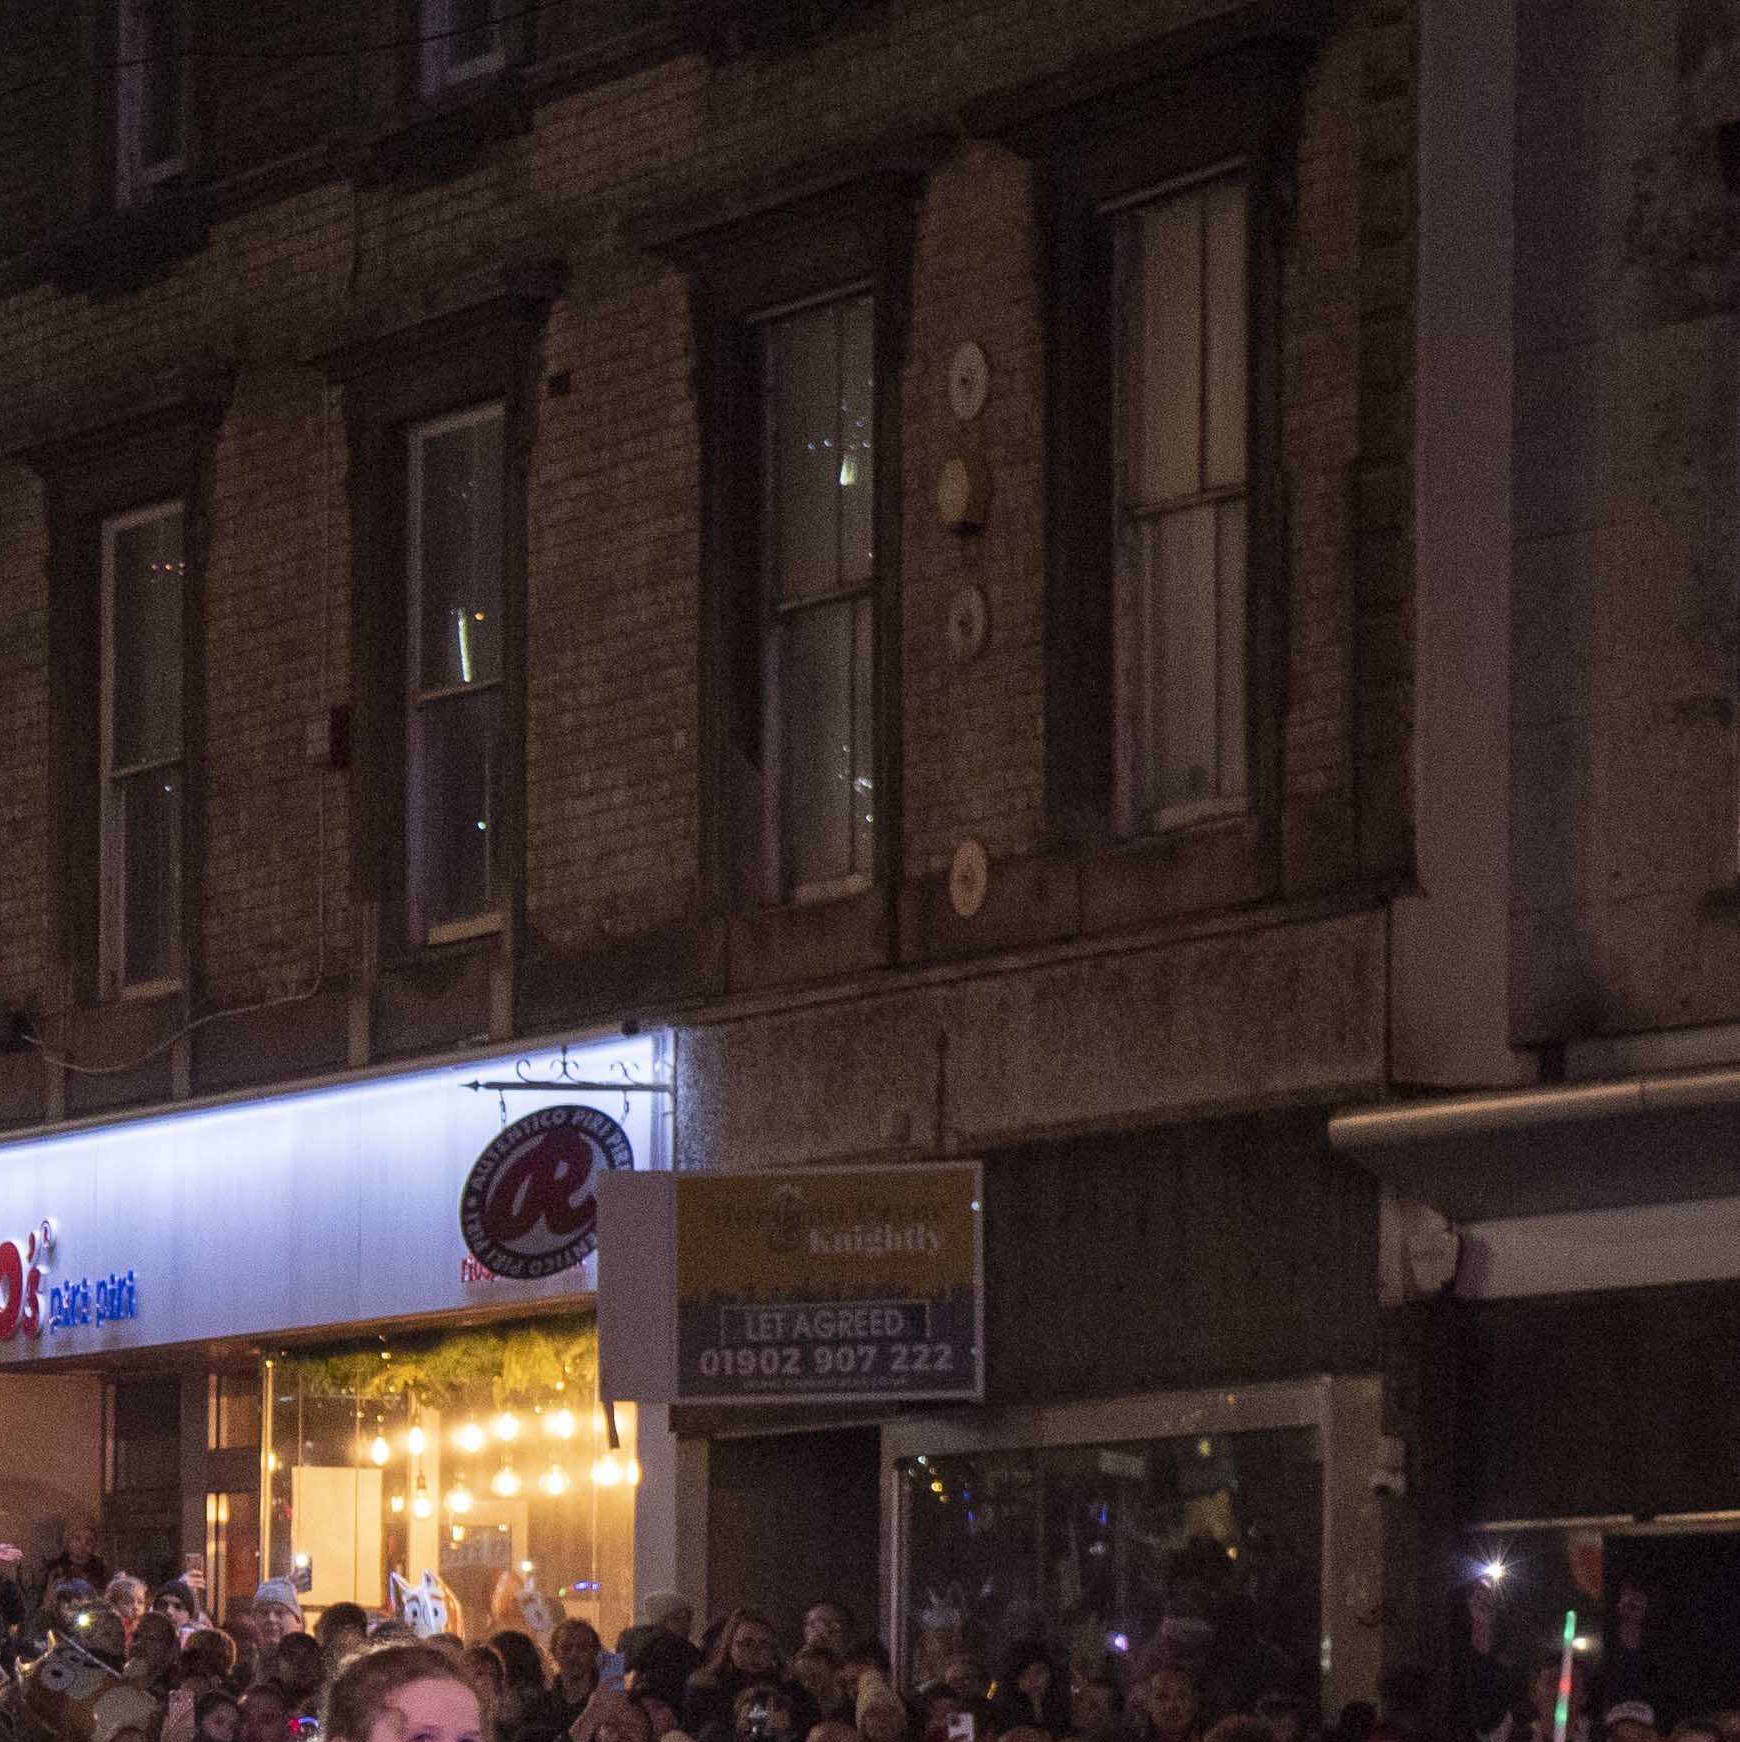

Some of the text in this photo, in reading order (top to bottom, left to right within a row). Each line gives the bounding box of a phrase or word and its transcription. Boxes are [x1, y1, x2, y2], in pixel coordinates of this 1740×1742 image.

[745, 1309, 905, 1341] LET AGREED
[699, 1343, 954, 1376] 01902 907 222
